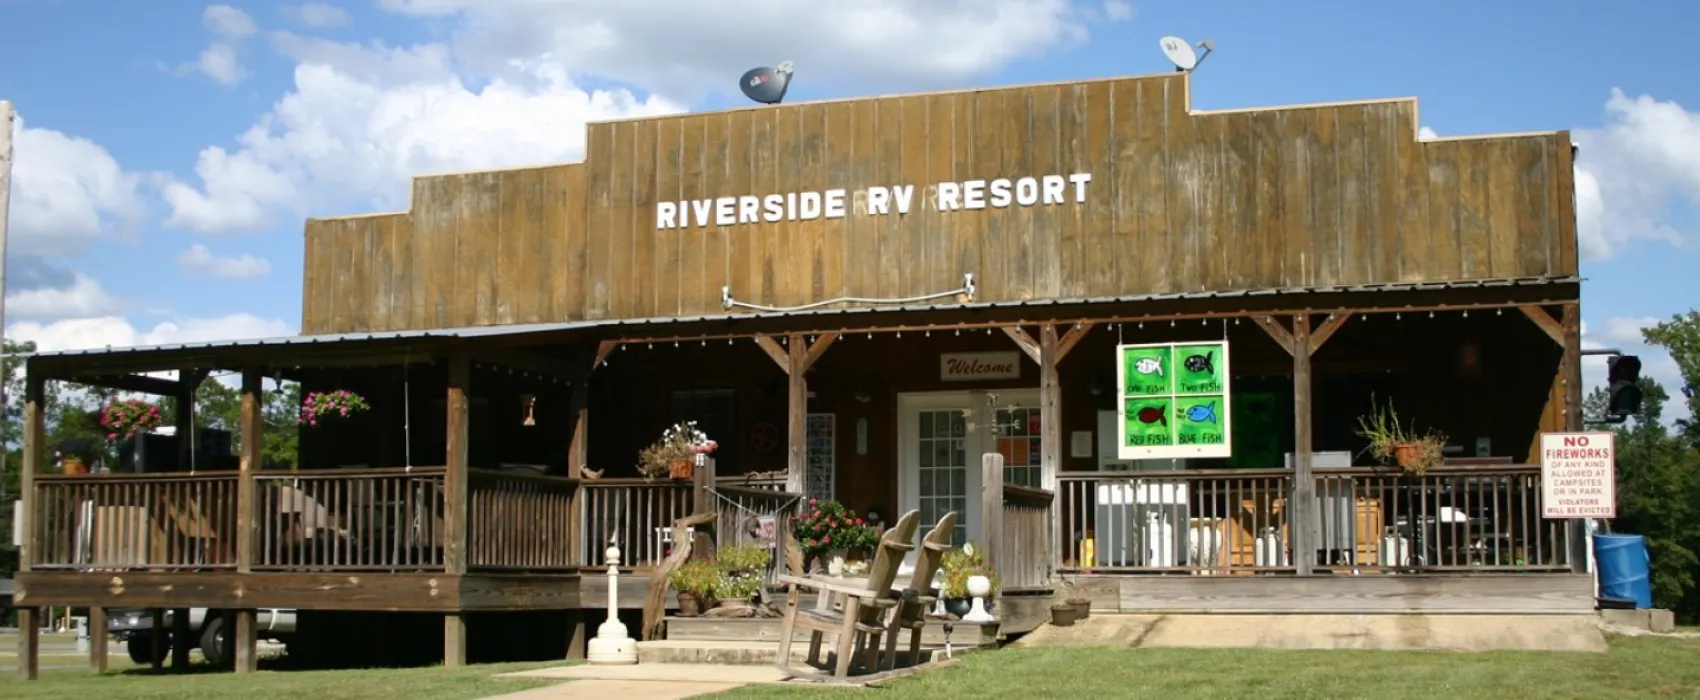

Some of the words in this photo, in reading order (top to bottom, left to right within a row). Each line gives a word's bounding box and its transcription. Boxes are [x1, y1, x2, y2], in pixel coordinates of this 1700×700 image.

[656, 189, 846, 229] RIVERSIDE
[867, 184, 914, 215] RV
[937, 173, 1092, 212] RESORT
[946, 358, 1014, 375] Welcome
[1564, 436, 1589, 447] NO
[1546, 448, 1610, 459] FIREWORKS
[1584, 460, 1605, 468] KIND
[1553, 479, 1602, 487] CAMPSITES
[1558, 498, 1599, 506] VIOLATORS
[1579, 506, 1611, 514] EVICTED
